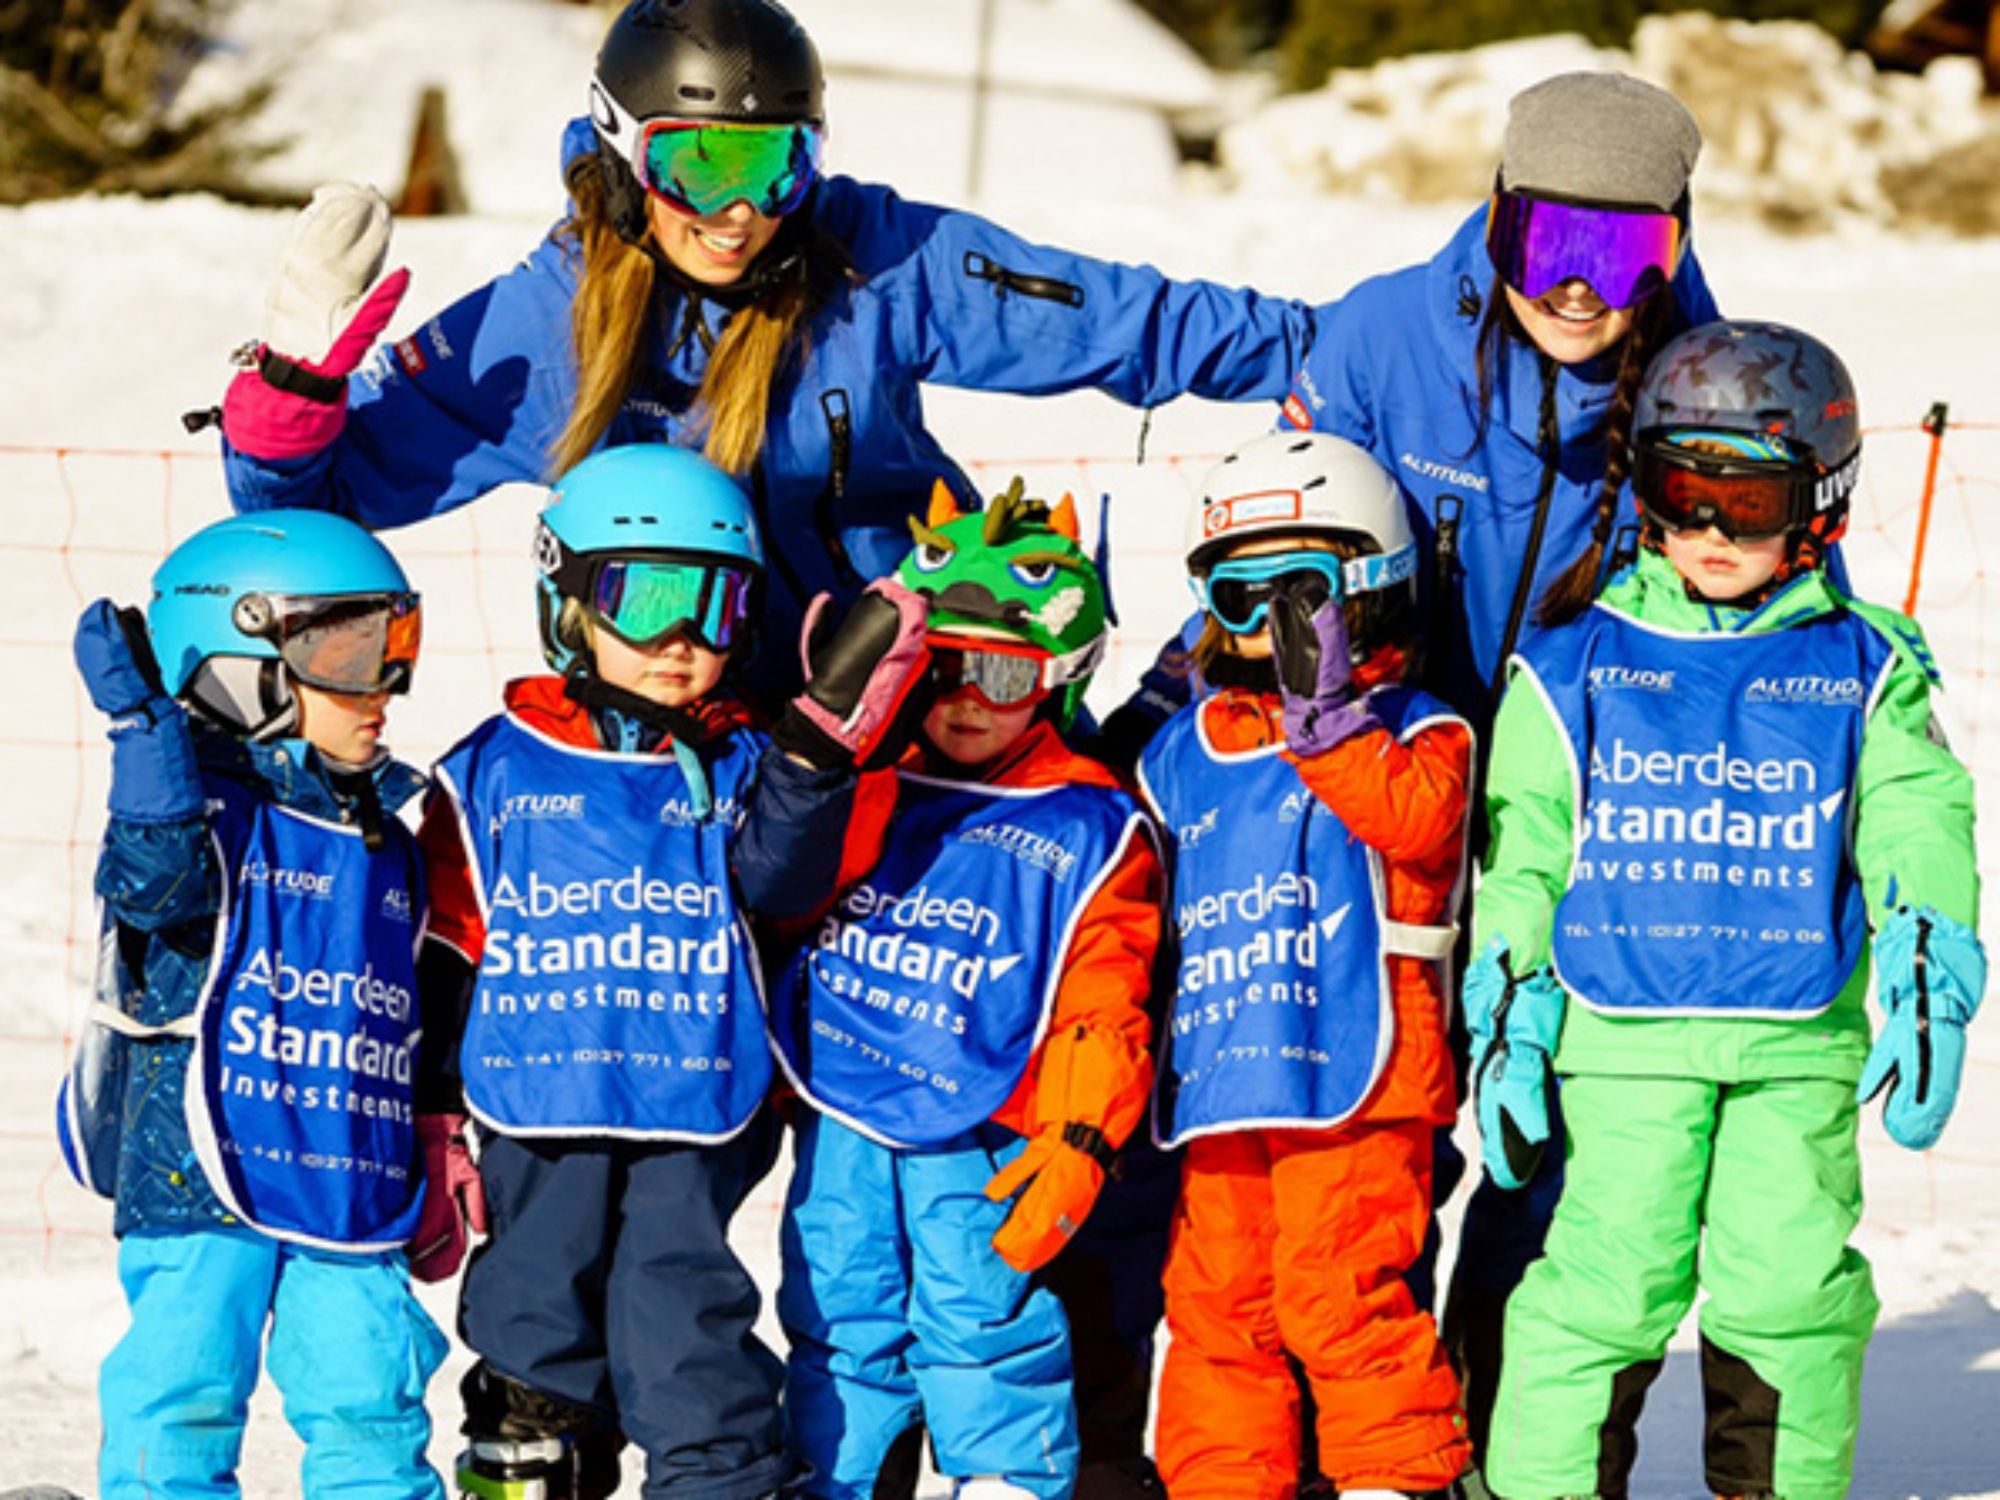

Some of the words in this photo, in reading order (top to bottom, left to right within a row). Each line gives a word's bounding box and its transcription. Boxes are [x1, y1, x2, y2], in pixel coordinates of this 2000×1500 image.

[174, 583, 231, 597] HEAD
[1747, 677, 1863, 697] ALTITUD
[1590, 738, 1815, 793] Aberdeen
[493, 866, 724, 917] Aberdeen
[1575, 858, 1814, 887] nvestments
[848, 885, 1000, 947] erdeen
[1710, 925, 1748, 940] 771
[1759, 929, 1789, 942] 60
[1795, 929, 1825, 944] 06
[482, 923, 729, 975] Standard
[818, 916, 985, 1000] andard
[1178, 922, 1316, 997] andard
[237, 947, 411, 1024] Aberdeen
[481, 983, 728, 1014] Investments
[819, 969, 967, 1034] estments
[227, 1005, 412, 1085] Standard
[631, 1053, 671, 1068] 771
[681, 1057, 709, 1071] 60
